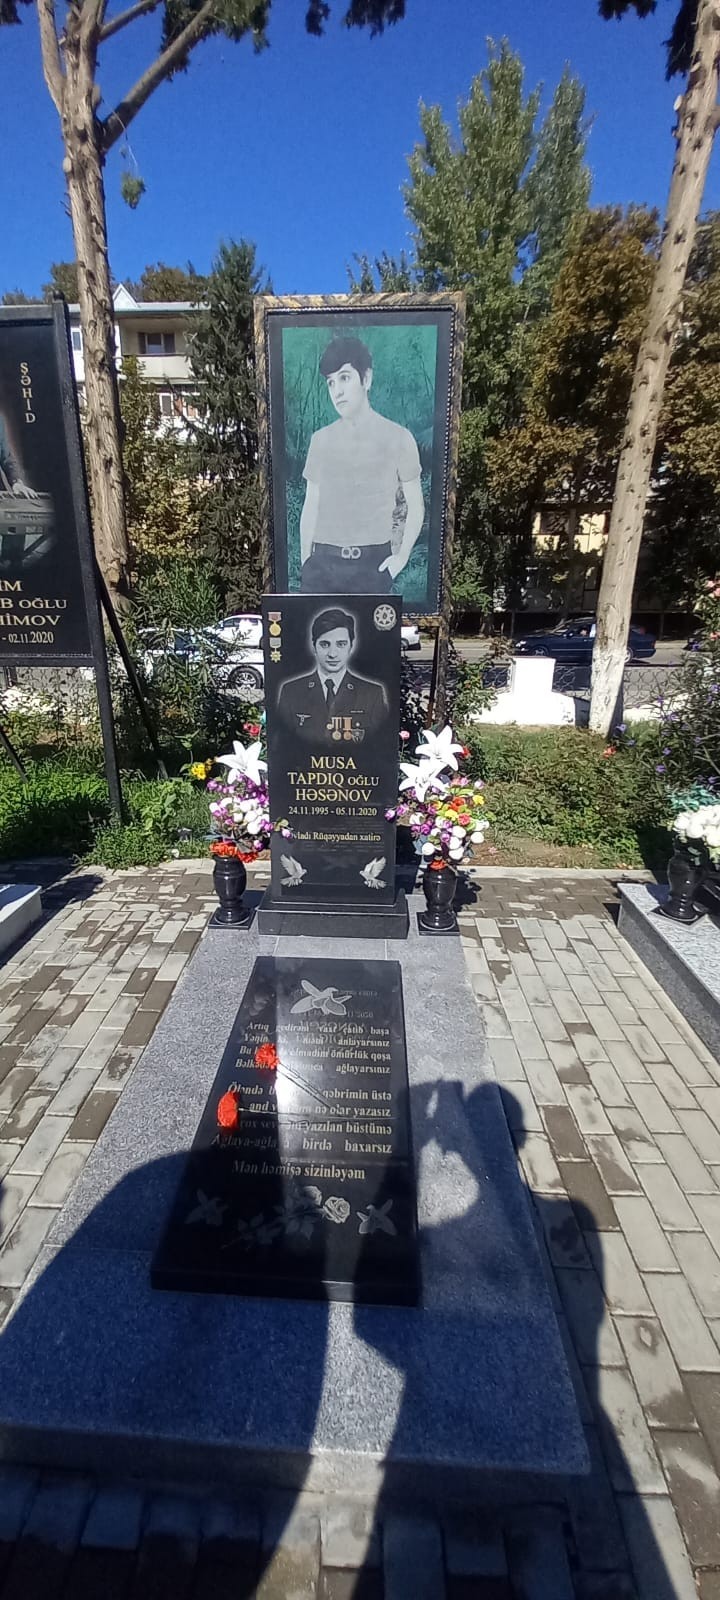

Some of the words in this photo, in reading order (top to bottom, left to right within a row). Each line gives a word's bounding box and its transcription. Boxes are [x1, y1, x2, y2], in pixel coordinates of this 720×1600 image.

[18, 597, 67, 609] OĞLU
[8, 631, 55, 644] 02.11.2020
[311, 756, 357, 770] MUSA
[287, 772, 344, 787] TAPDIQ
[347, 775, 380, 786] OĞLU
[295, 788, 373, 802] HƏSƏNOV
[288, 806, 329, 816] 24.11.1995
[335, 807, 378, 817] 05.11.2020
[370, 1026, 390, 1037] başa
[239, 1045, 252, 1055] Bu
[371, 1089, 392, 1101] üstə
[249, 1100, 270, 1111] and
[346, 1121, 392, 1135] büstümə
[302, 1137, 333, 1151] birdə
[344, 1139, 393, 1154] baxarsız
[304, 1164, 366, 1181] sizinləyəm
